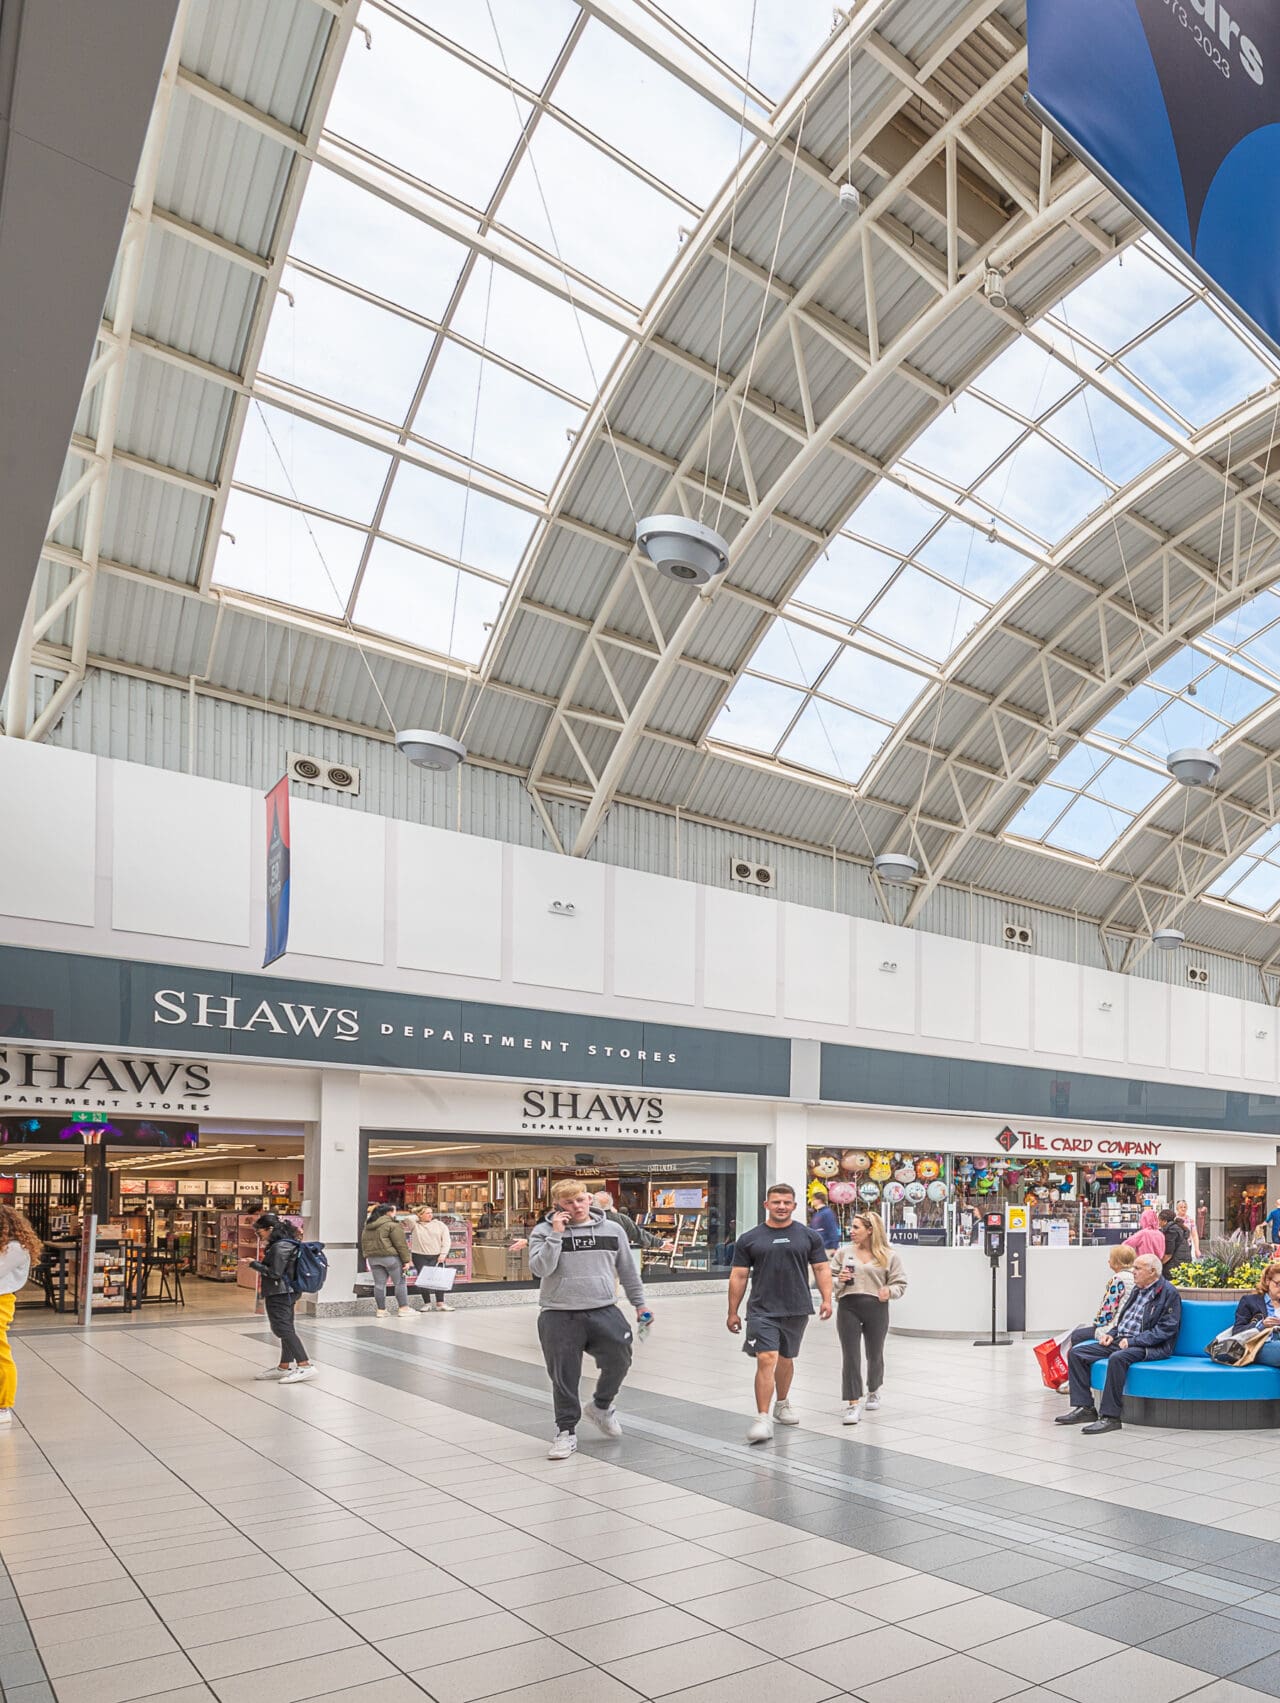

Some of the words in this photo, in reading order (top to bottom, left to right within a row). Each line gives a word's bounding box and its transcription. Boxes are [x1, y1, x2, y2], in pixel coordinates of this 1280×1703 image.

[1164, 0, 1230, 79] 73-2023
[153, 989, 360, 1041] SHAWS
[380, 1023, 571, 1052] DEPARTMENT
[588, 1044, 678, 1064] STORES
[135, 1101, 210, 1112] STORES
[522, 1089, 665, 1124] SHAWS
[521, 1122, 609, 1133] DEPARTMENT
[617, 1127, 663, 1135] STORES
[1018, 1131, 1048, 1150] THE
[1051, 1138, 1093, 1152] CARD
[1097, 1139, 1162, 1156] COMPANY
[890, 1232, 919, 1240] ATION
